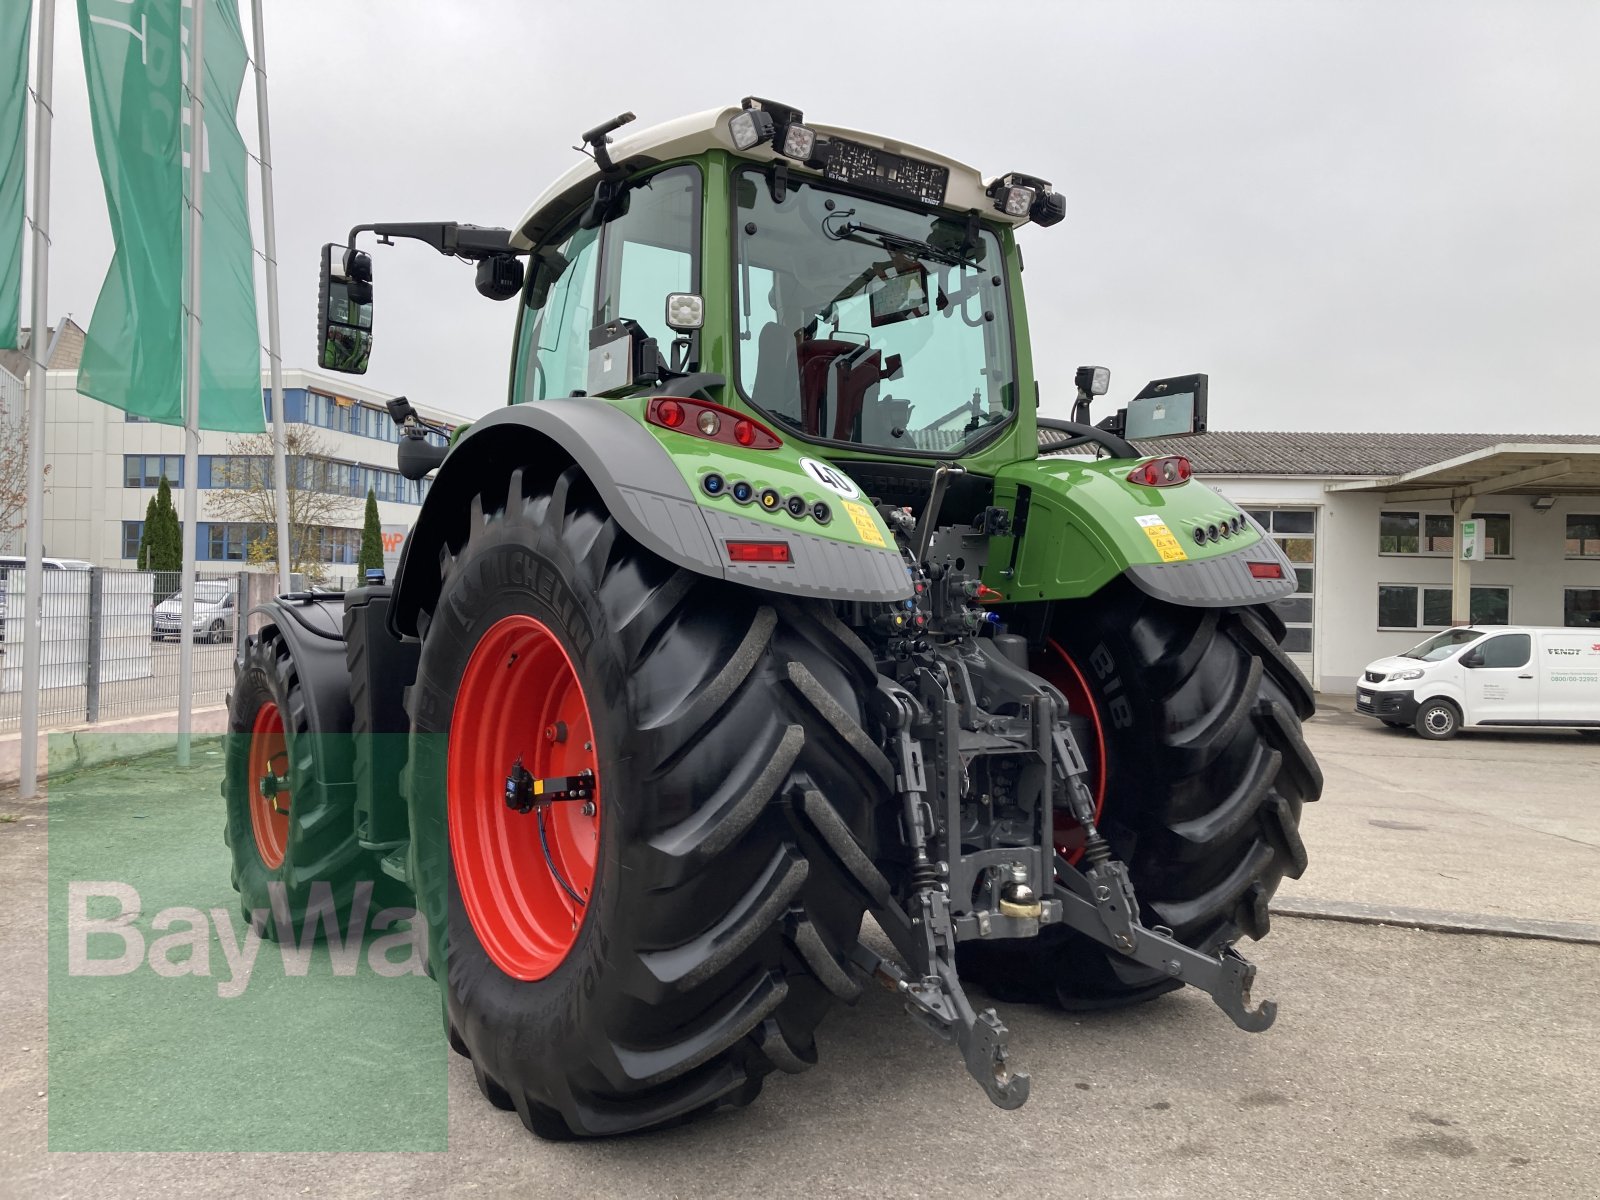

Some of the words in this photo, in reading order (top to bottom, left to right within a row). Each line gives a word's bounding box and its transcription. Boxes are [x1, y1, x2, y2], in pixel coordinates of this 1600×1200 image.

[920, 196, 941, 206] FENDT
[809, 461, 852, 493] 40
[479, 551, 595, 655] MICHELIN
[1088, 640, 1134, 730] BIB
